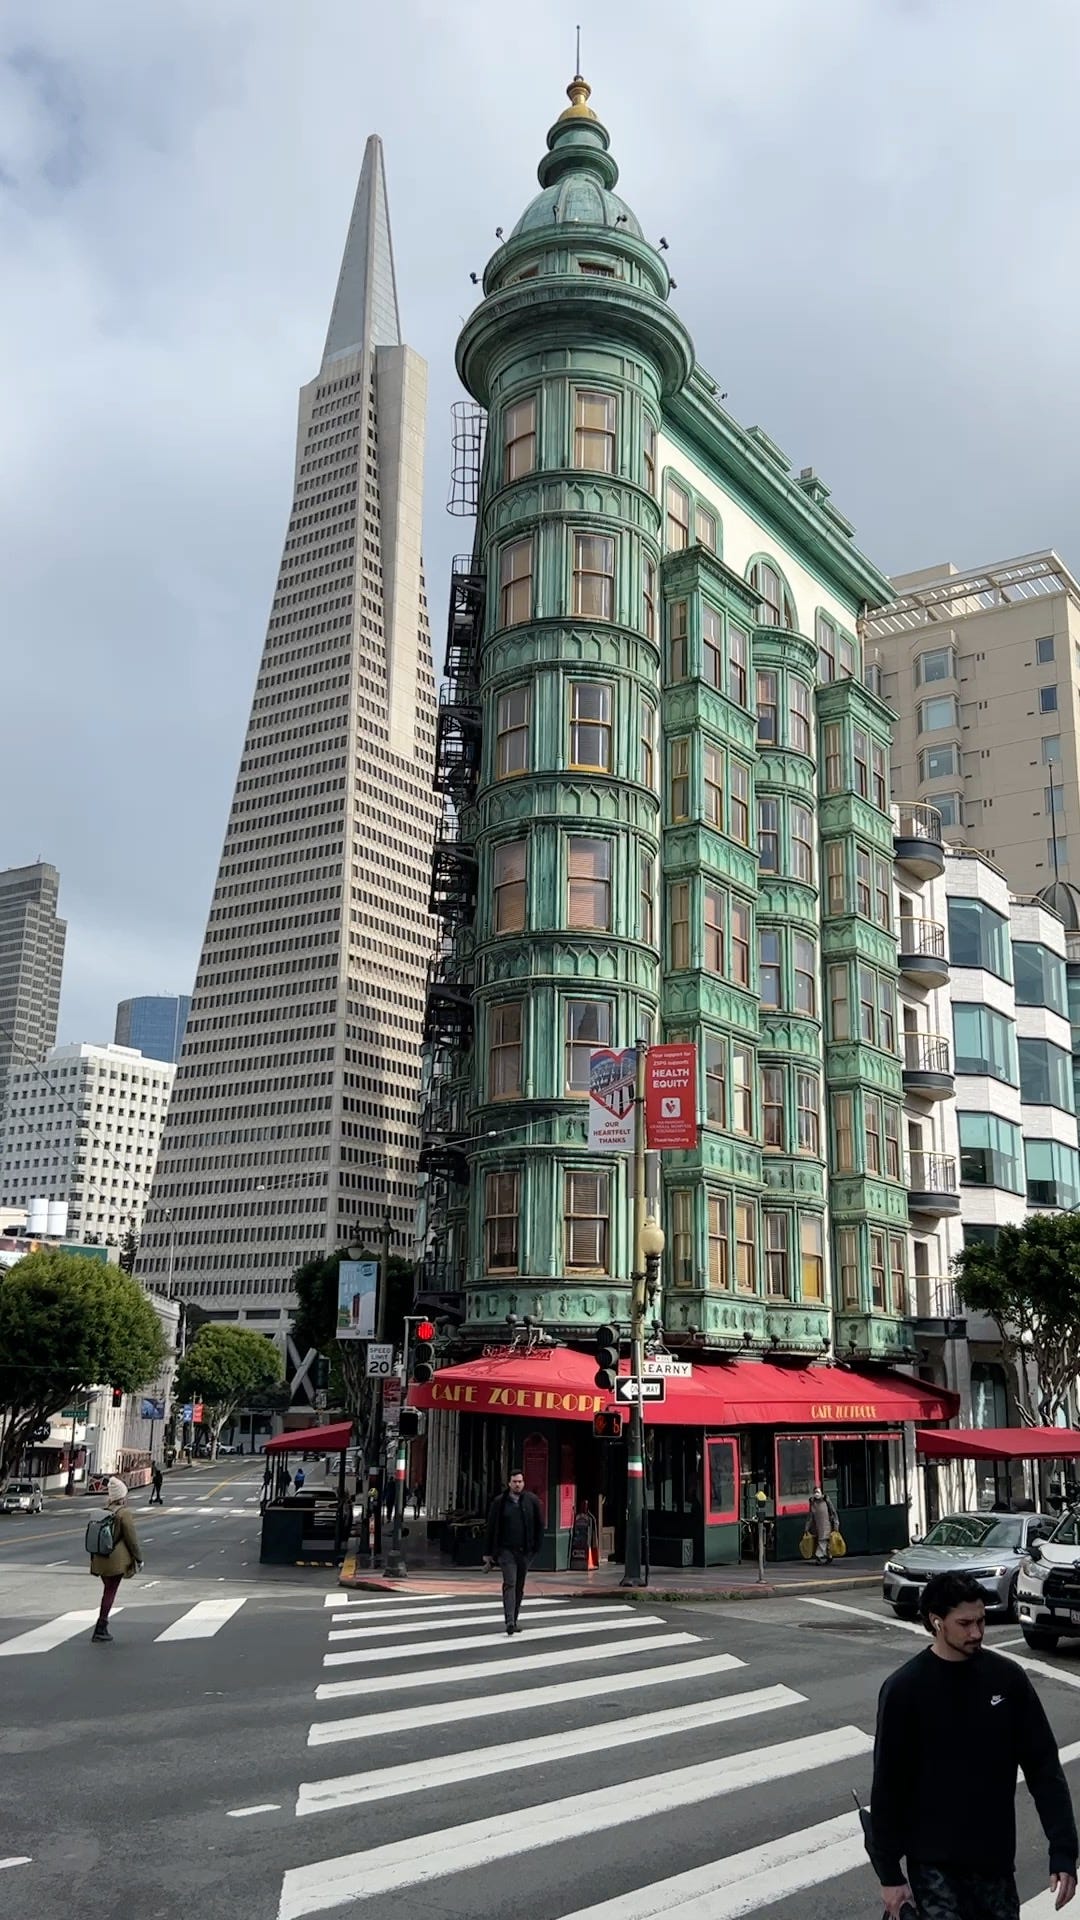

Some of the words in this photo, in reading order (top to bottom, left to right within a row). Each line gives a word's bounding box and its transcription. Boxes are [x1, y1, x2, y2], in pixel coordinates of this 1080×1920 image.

[652, 1068, 690, 1078] HEALTH
[653, 1079, 689, 1088] EQUITY
[369, 1361, 390, 1373] 20
[646, 1385, 659, 1393] WAY
[431, 1383, 478, 1403] CAFE
[488, 1387, 606, 1413] ZOETROPE
[811, 1404, 832, 1419] CAFE
